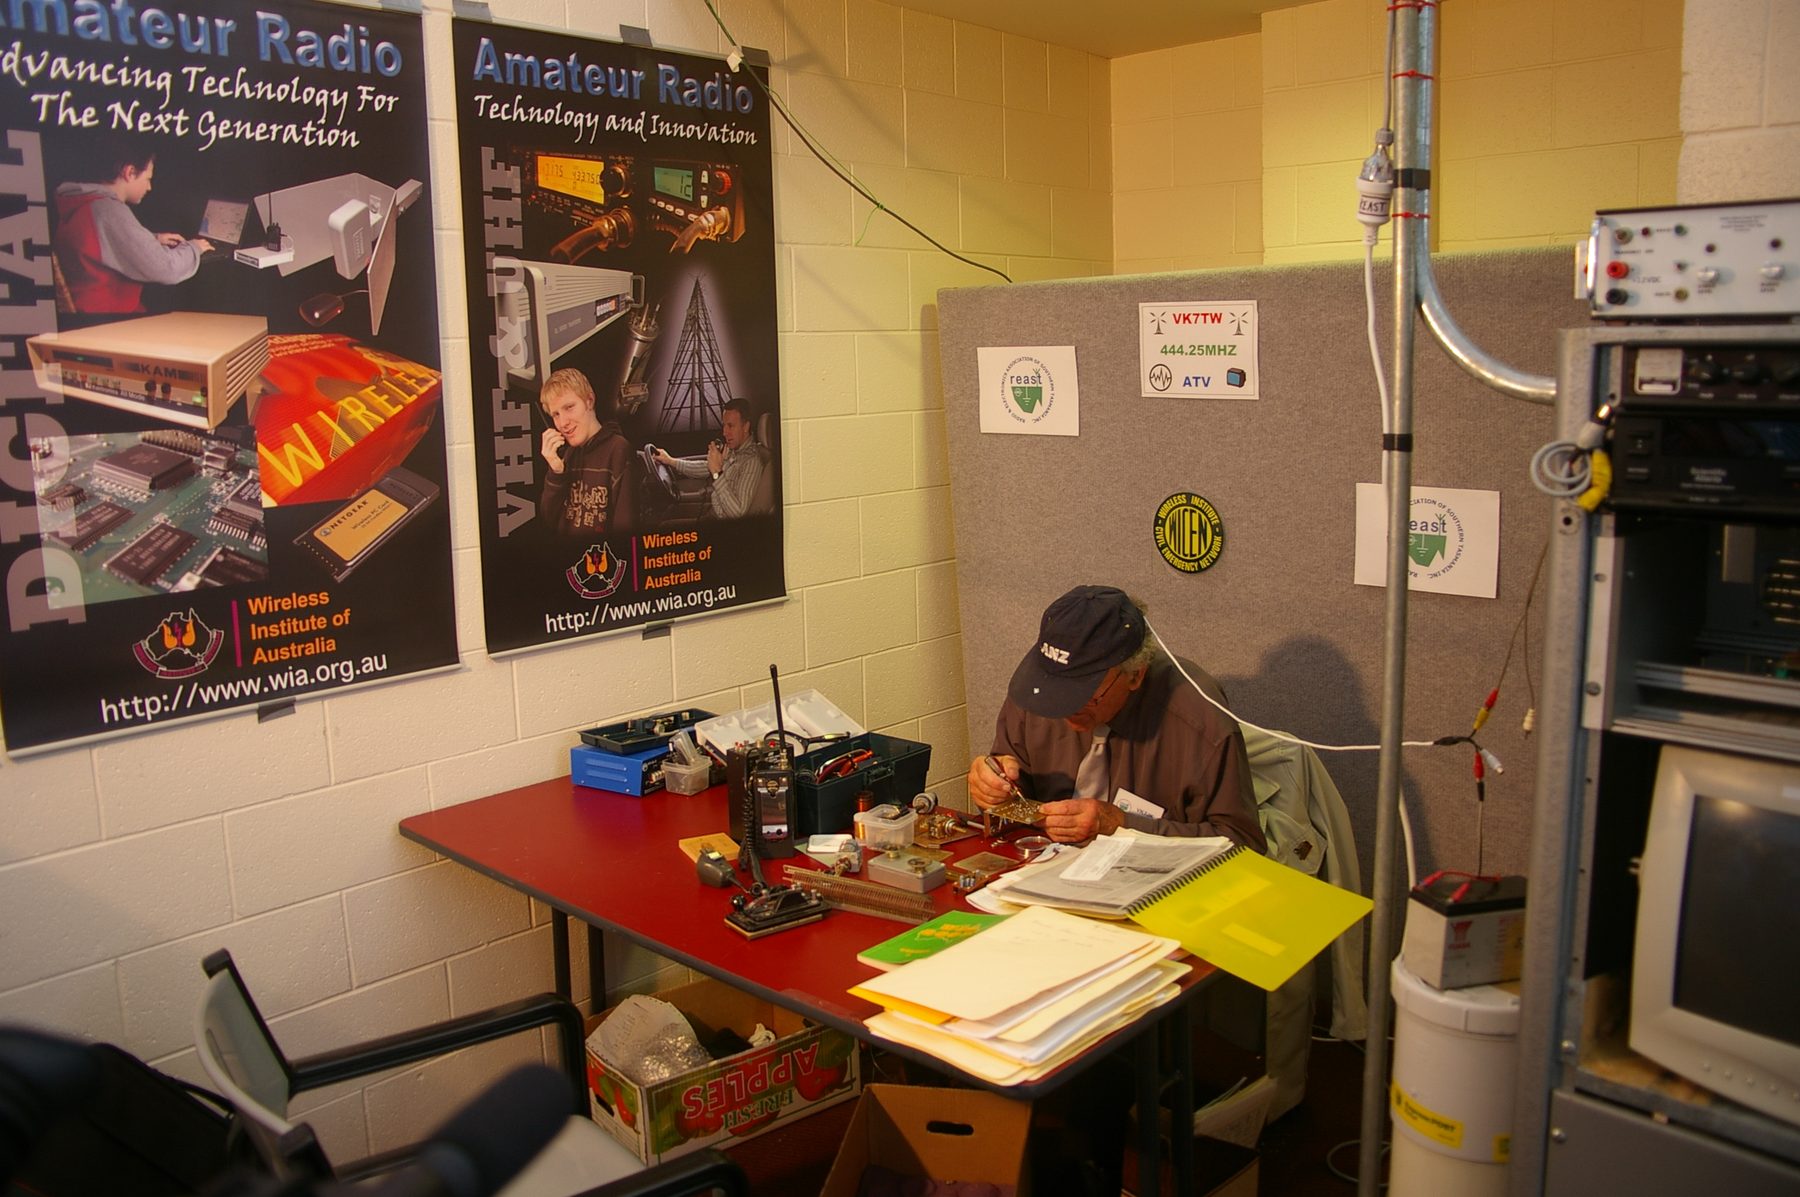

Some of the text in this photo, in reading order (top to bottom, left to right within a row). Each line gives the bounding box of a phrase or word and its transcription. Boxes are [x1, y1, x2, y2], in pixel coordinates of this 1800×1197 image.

[0, 0, 402, 77] mateur Radio
[0, 41, 399, 126] dvancing Technology For
[473, 37, 754, 114] Amateur Radio
[31, 91, 360, 151] The Next Generation
[474, 94, 758, 145] Technology and Innovation
[481, 146, 525, 297] UHF
[1172, 312, 1223, 324] VK7TW
[1160, 344, 1237, 356] 444.25MHZ
[140, 363, 178, 380] KAM
[1010, 373, 1043, 385] reast
[1182, 376, 1211, 387] ATV
[492, 387, 537, 537] VHF
[330, 499, 368, 530] NETGEAR
[1157, 494, 1220, 525] WIRELESS INSTITUTE
[1437, 502, 1446, 510] OF
[643, 531, 698, 549] Wireless
[1168, 507, 1208, 557] WICEN
[1409, 518, 1447, 534] east
[1446, 508, 1464, 543] SOUTHERN
[643, 546, 712, 570] Institute of
[1155, 526, 1222, 571] CIVIL EMERGENCY NETWORK
[1441, 545, 1464, 574] TASMANIA
[644, 569, 701, 590] Australia
[247, 591, 330, 616] Wireless
[545, 584, 737, 634] http://www.wia.org.au
[250, 608, 351, 640] Institute of
[252, 637, 337, 666] Australia
[1040, 642, 1070, 664] ANZ
[100, 653, 388, 723] http://www.wia.org.au
[681, 1041, 821, 1120] APPLES
[721, 1089, 794, 1130] FRESH
